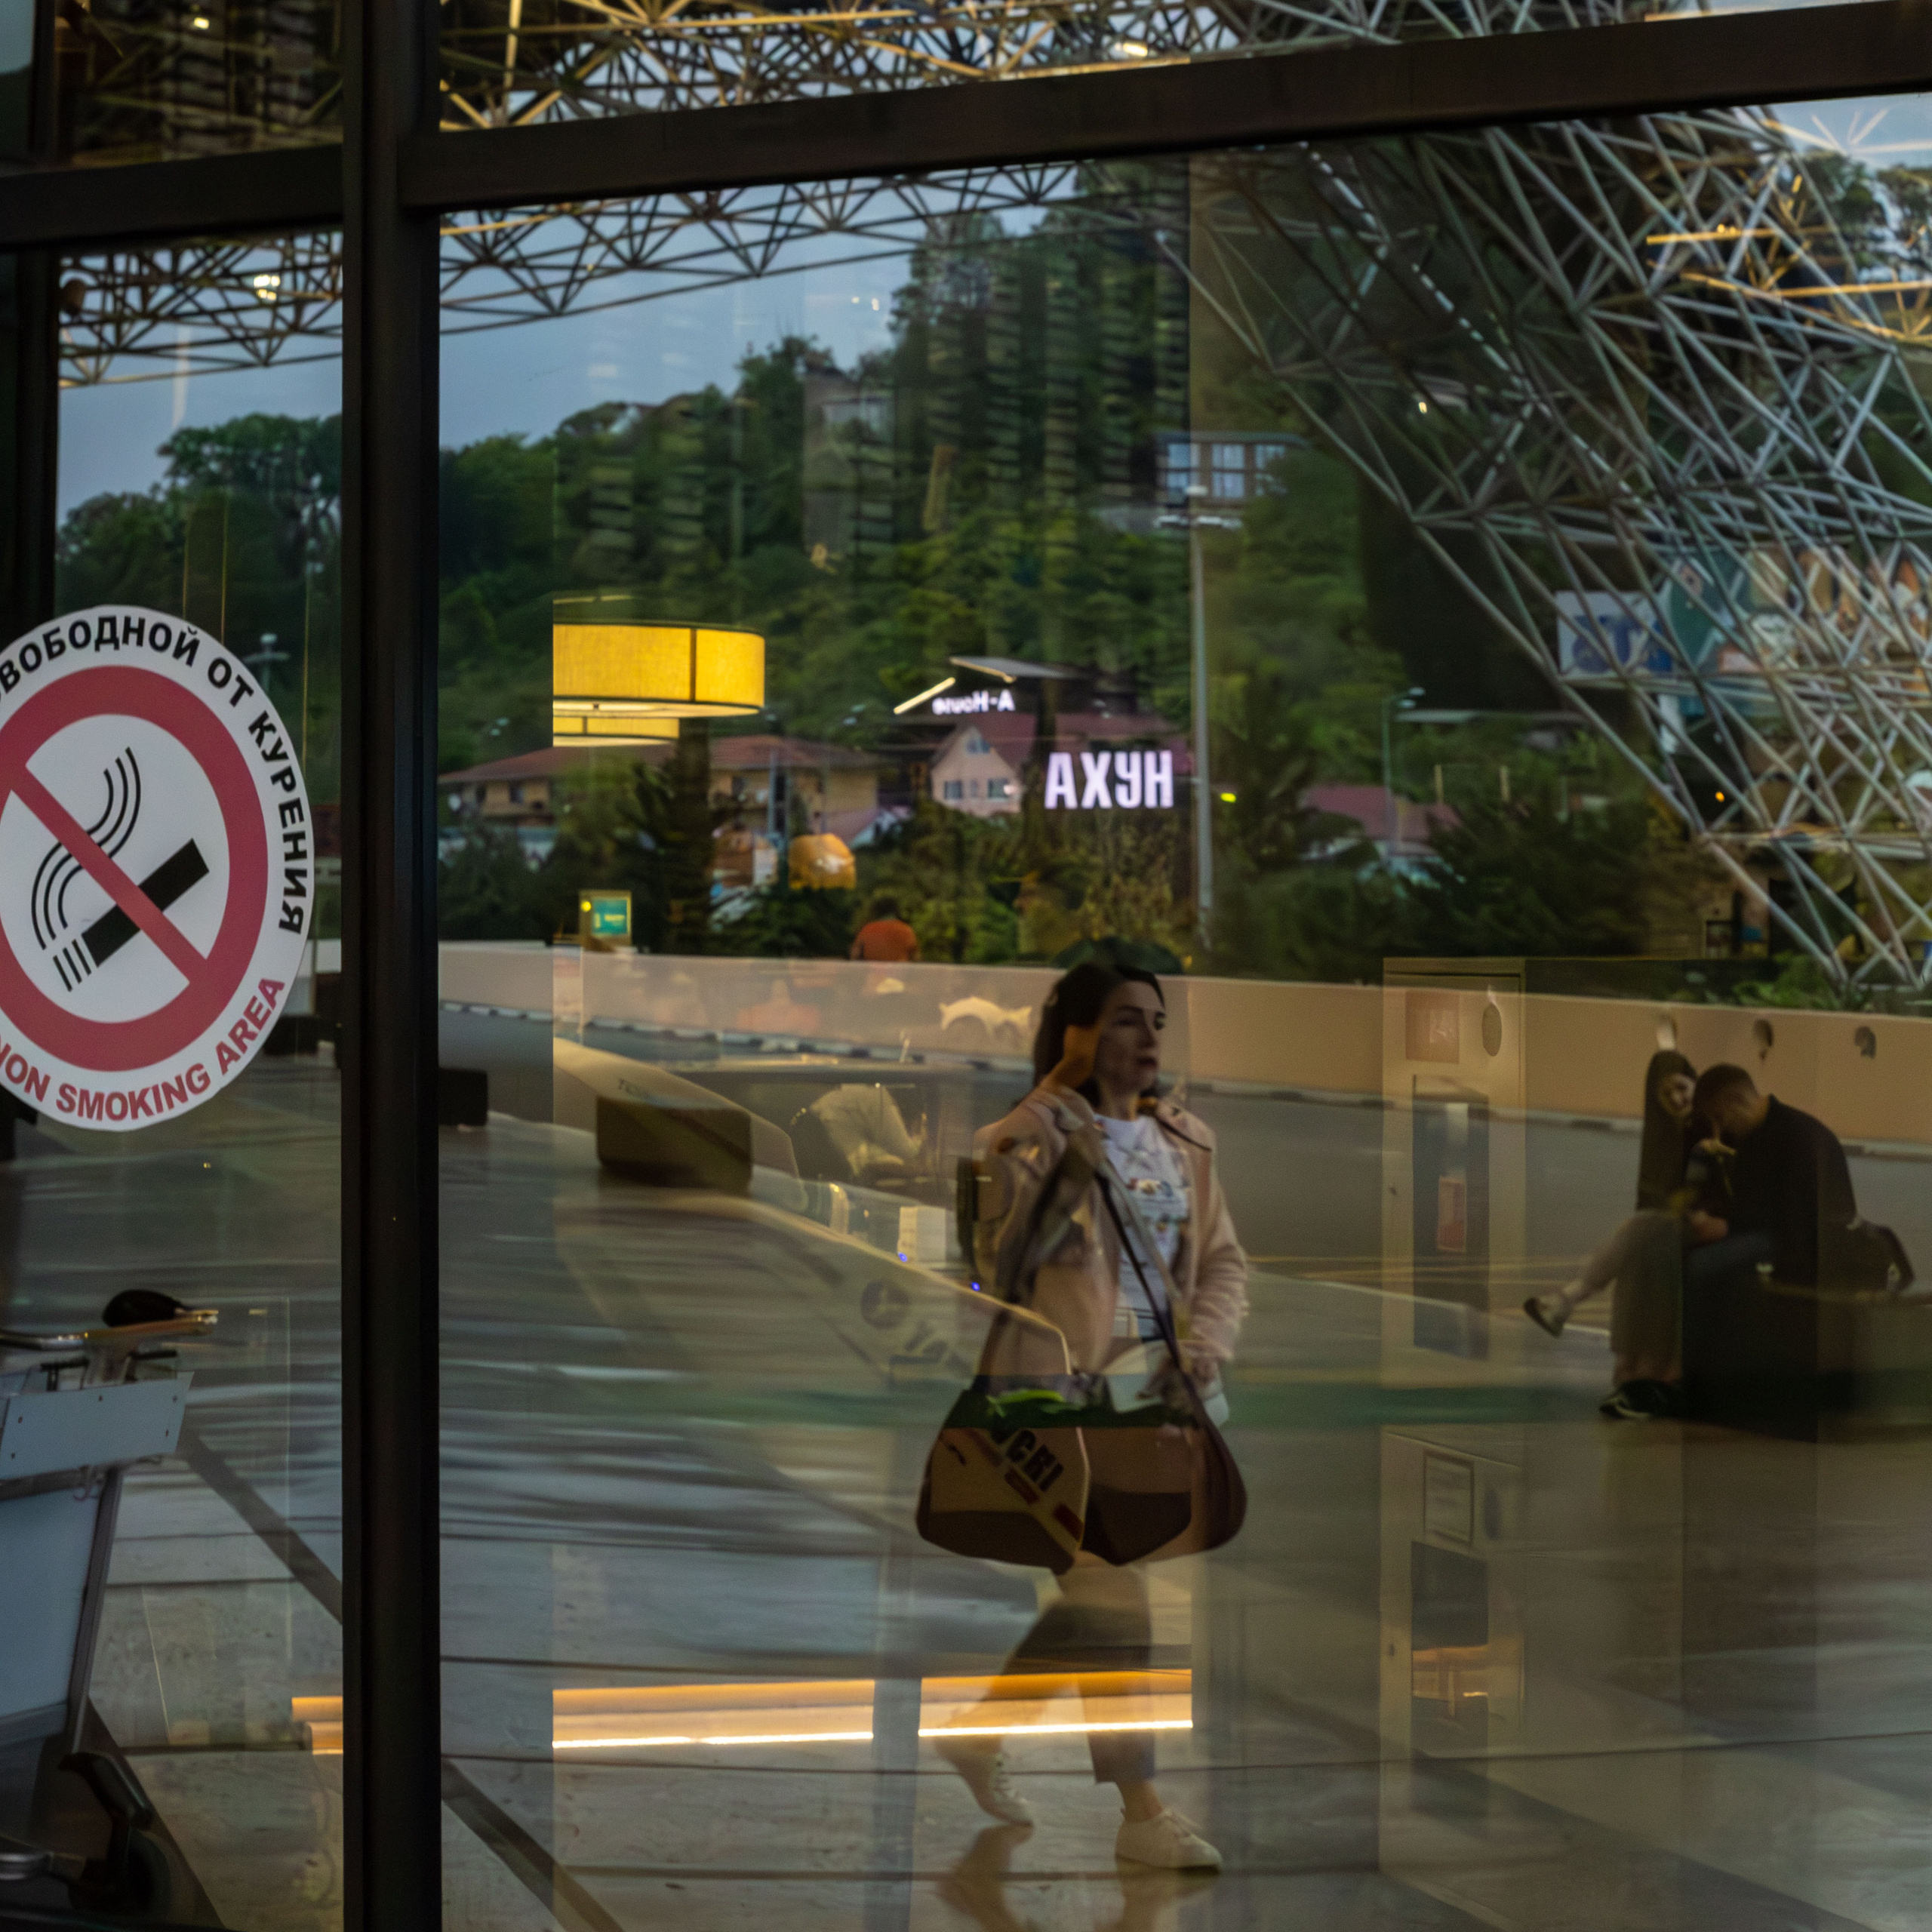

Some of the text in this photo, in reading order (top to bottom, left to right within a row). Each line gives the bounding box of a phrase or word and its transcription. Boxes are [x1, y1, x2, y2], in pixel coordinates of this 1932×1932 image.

[0, 615, 307, 934] ВОБОДНОЙ ОТ КУРЕНИЯ
[1044, 750, 1174, 809] АХУН
[56, 1063, 211, 1121] SMOKING
[216, 977, 285, 1075] AREA
